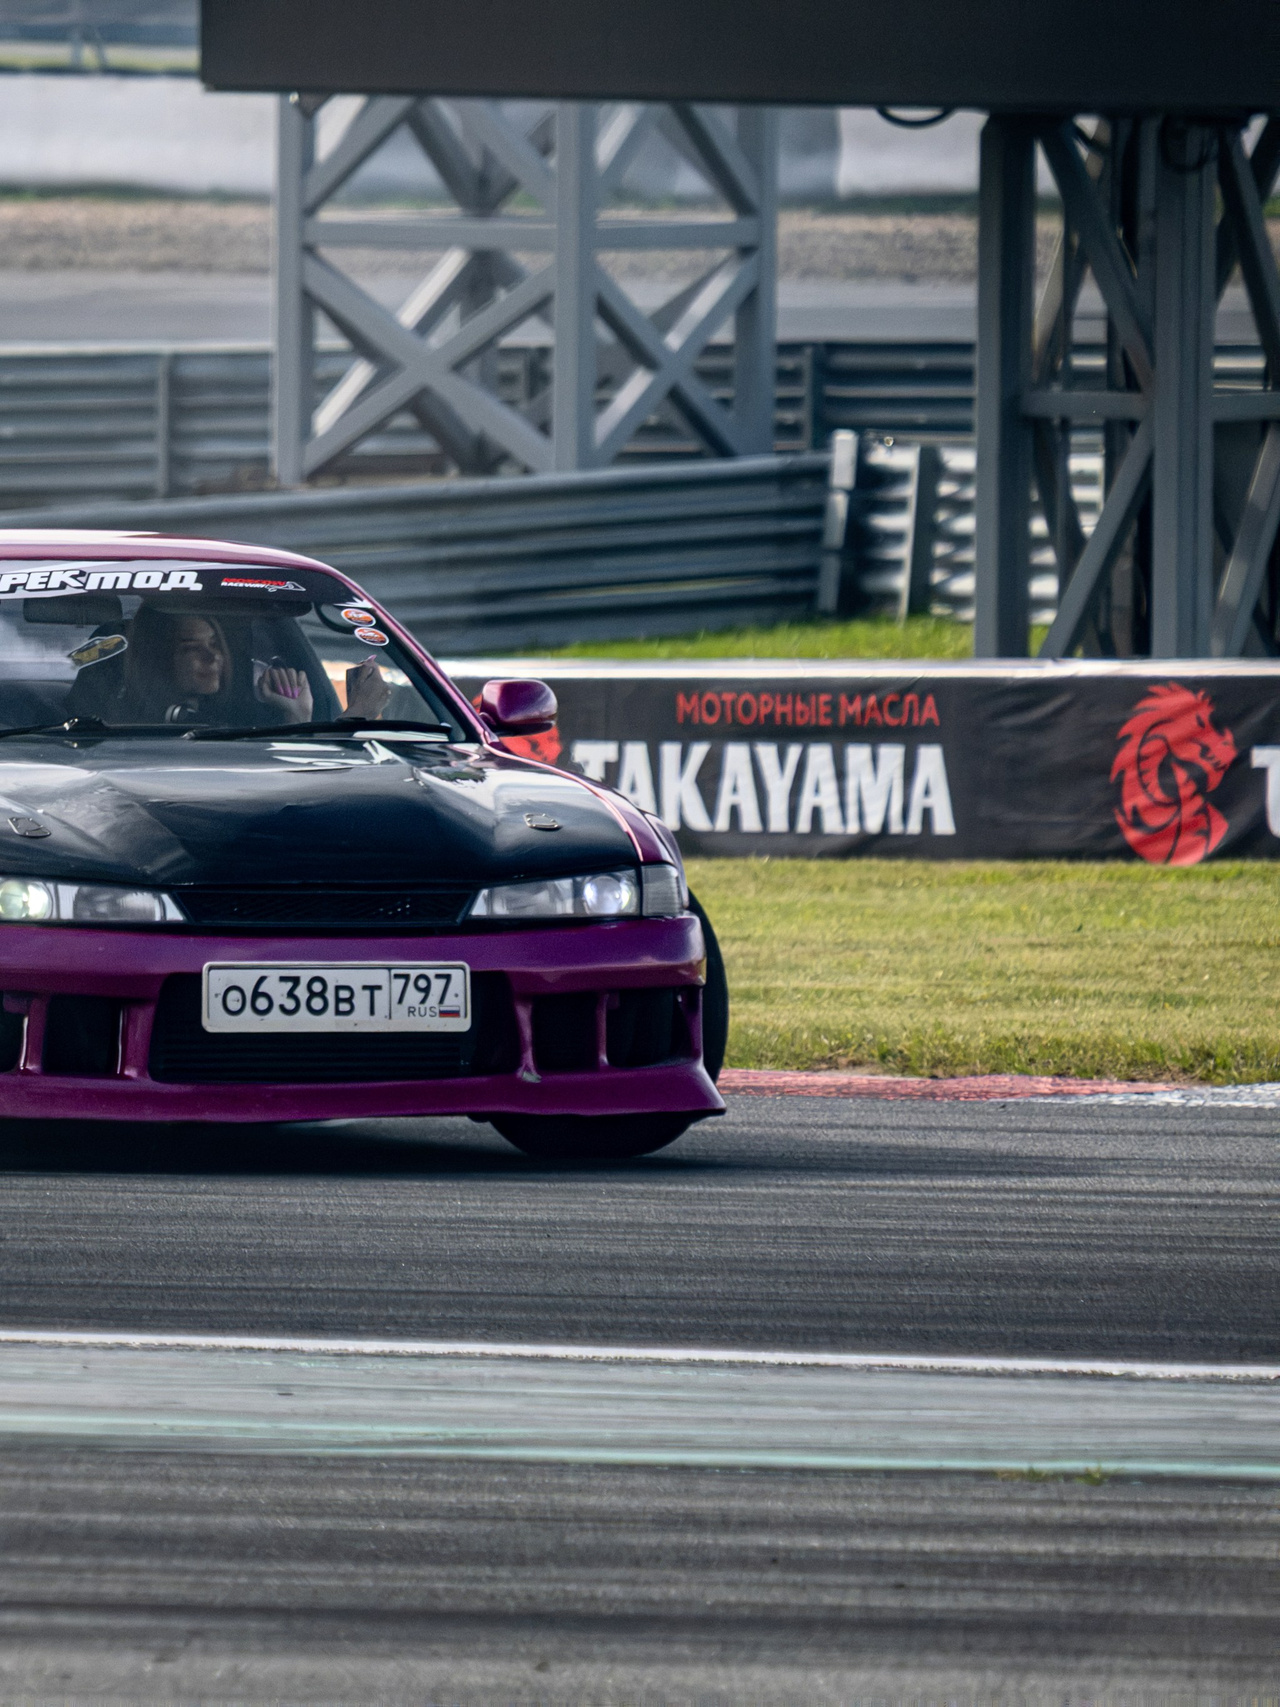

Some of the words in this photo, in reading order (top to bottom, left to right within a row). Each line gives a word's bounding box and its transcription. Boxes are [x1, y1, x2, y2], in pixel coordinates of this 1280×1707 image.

[676, 691, 833, 726] МОТОРНЫЕ
[839, 692, 940, 727] МАСЛА
[572, 740, 956, 835] TAKAYAMA
[393, 973, 452, 1005] 797
[407, 1005, 437, 1018] RUS
